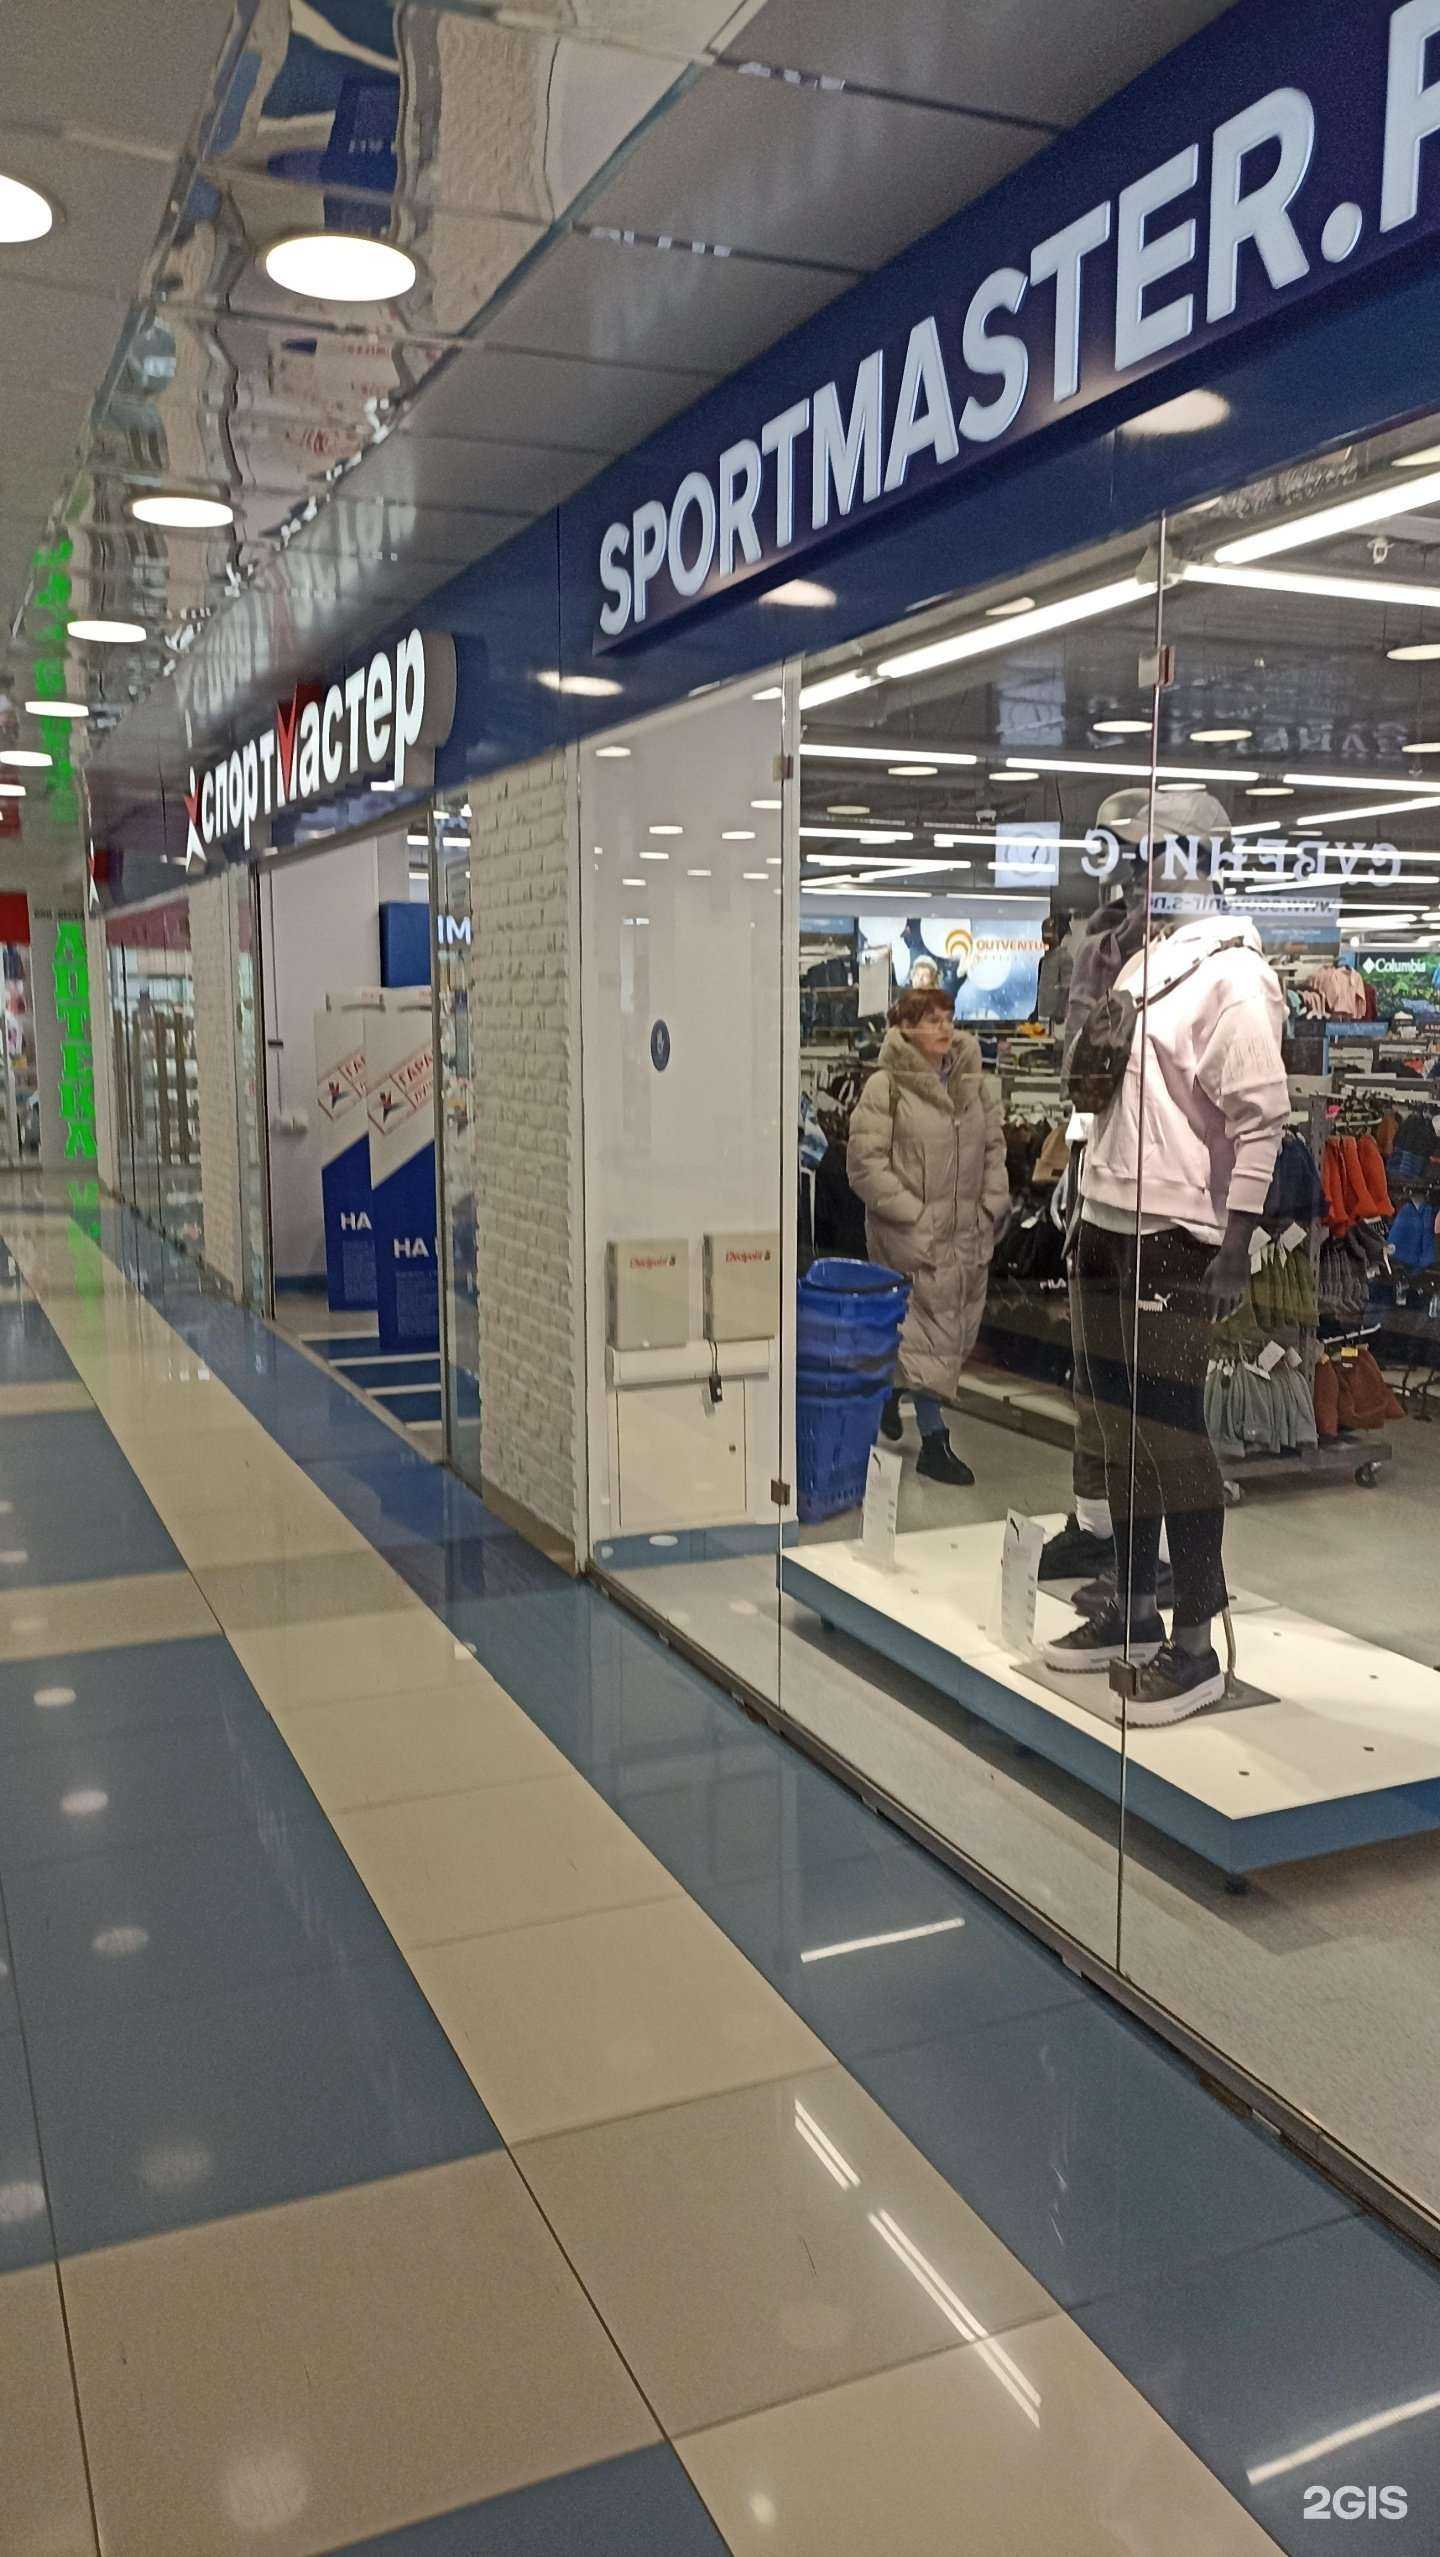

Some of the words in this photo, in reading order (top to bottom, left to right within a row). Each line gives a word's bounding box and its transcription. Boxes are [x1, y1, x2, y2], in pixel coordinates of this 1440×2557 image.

[1375, 958, 1426, 973] Columbia
[340, 1211, 373, 1231] НА
[393, 1237, 429, 1258] НА
[1040, 1278, 1067, 1290] FILA
